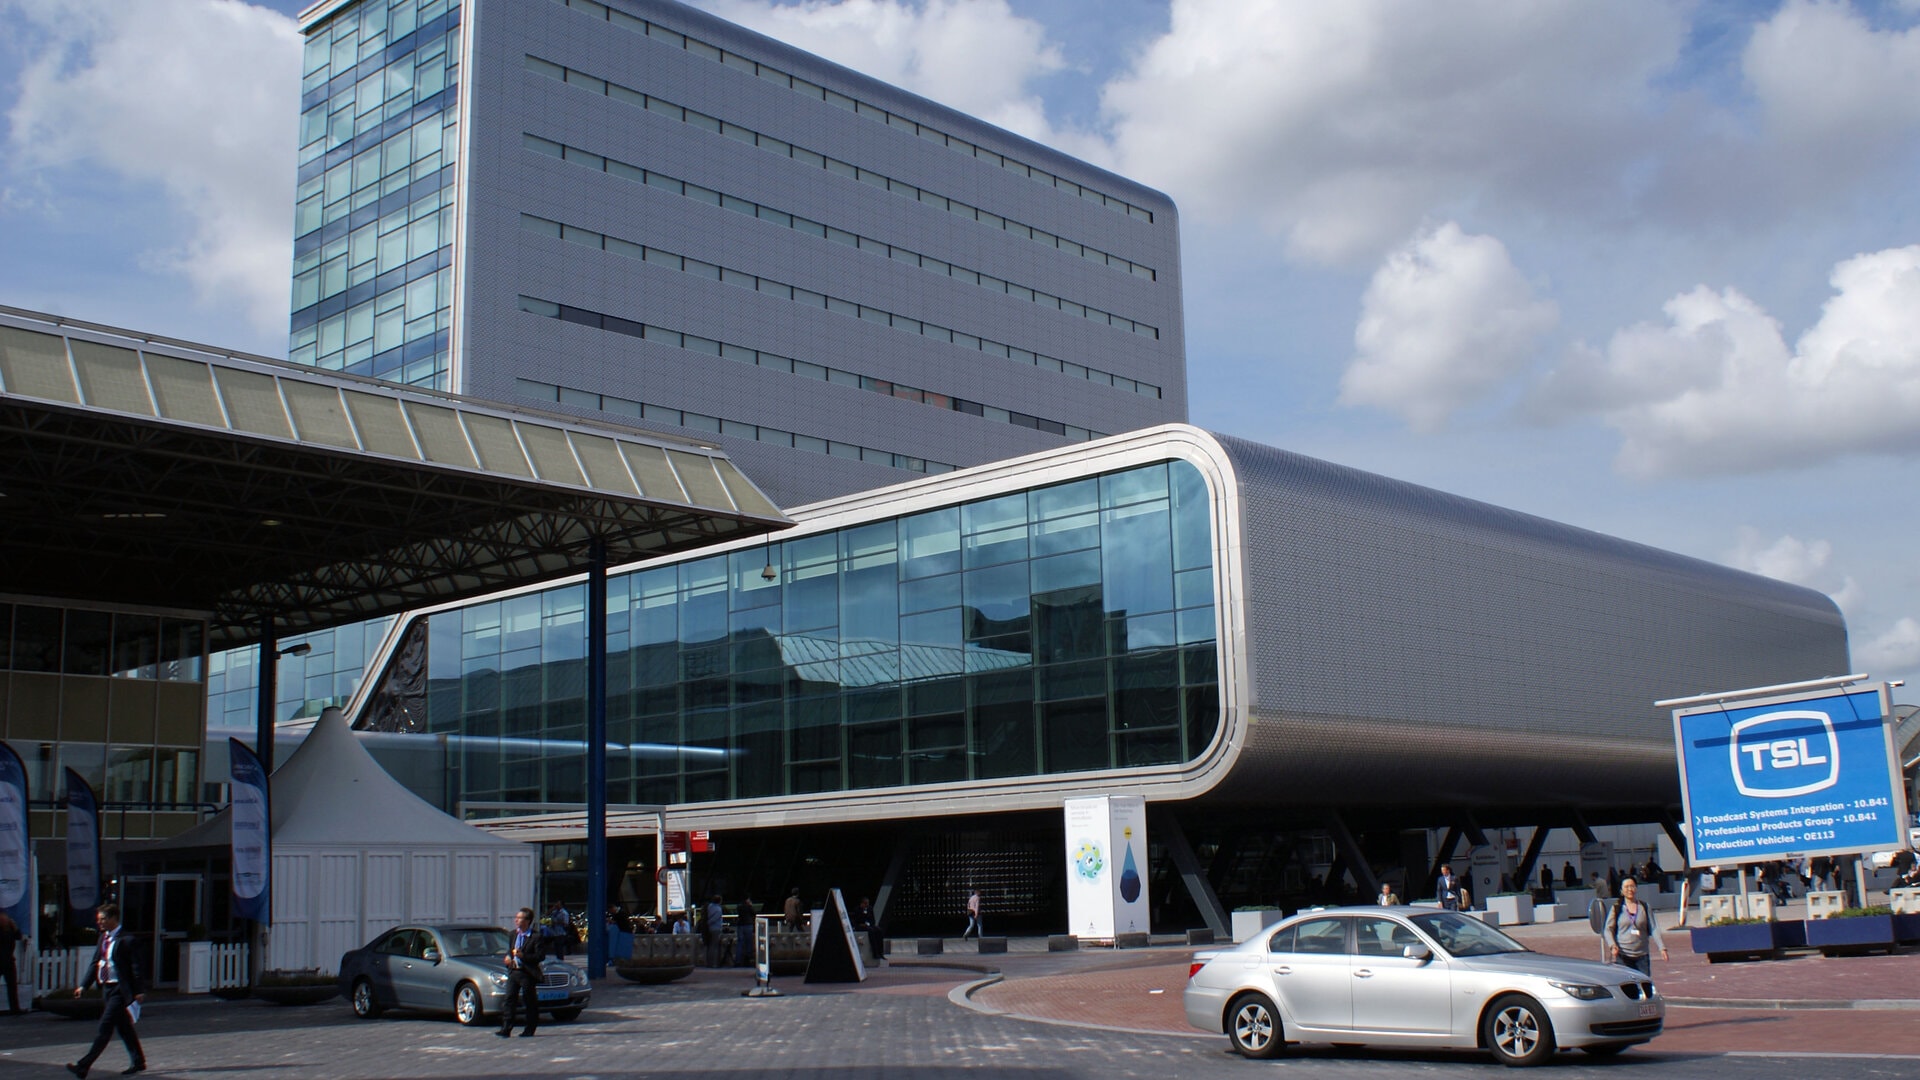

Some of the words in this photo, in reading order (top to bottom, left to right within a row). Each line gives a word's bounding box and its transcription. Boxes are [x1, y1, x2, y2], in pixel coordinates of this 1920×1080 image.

[1741, 738, 1827, 771] TSL
[1703, 812, 1748, 823] Broadcast
[1750, 808, 1788, 820] Systems
[1790, 802, 1844, 814] Integration
[1854, 797, 1888, 808] 10.B41
[1704, 824, 1759, 836] Professional
[1762, 820, 1803, 831] Products
[1804, 817, 1834, 827] Group
[1843, 812, 1877, 823] 10.B41
[1705, 839, 1755, 850] Production
[1756, 835, 1795, 845] Vehicles
